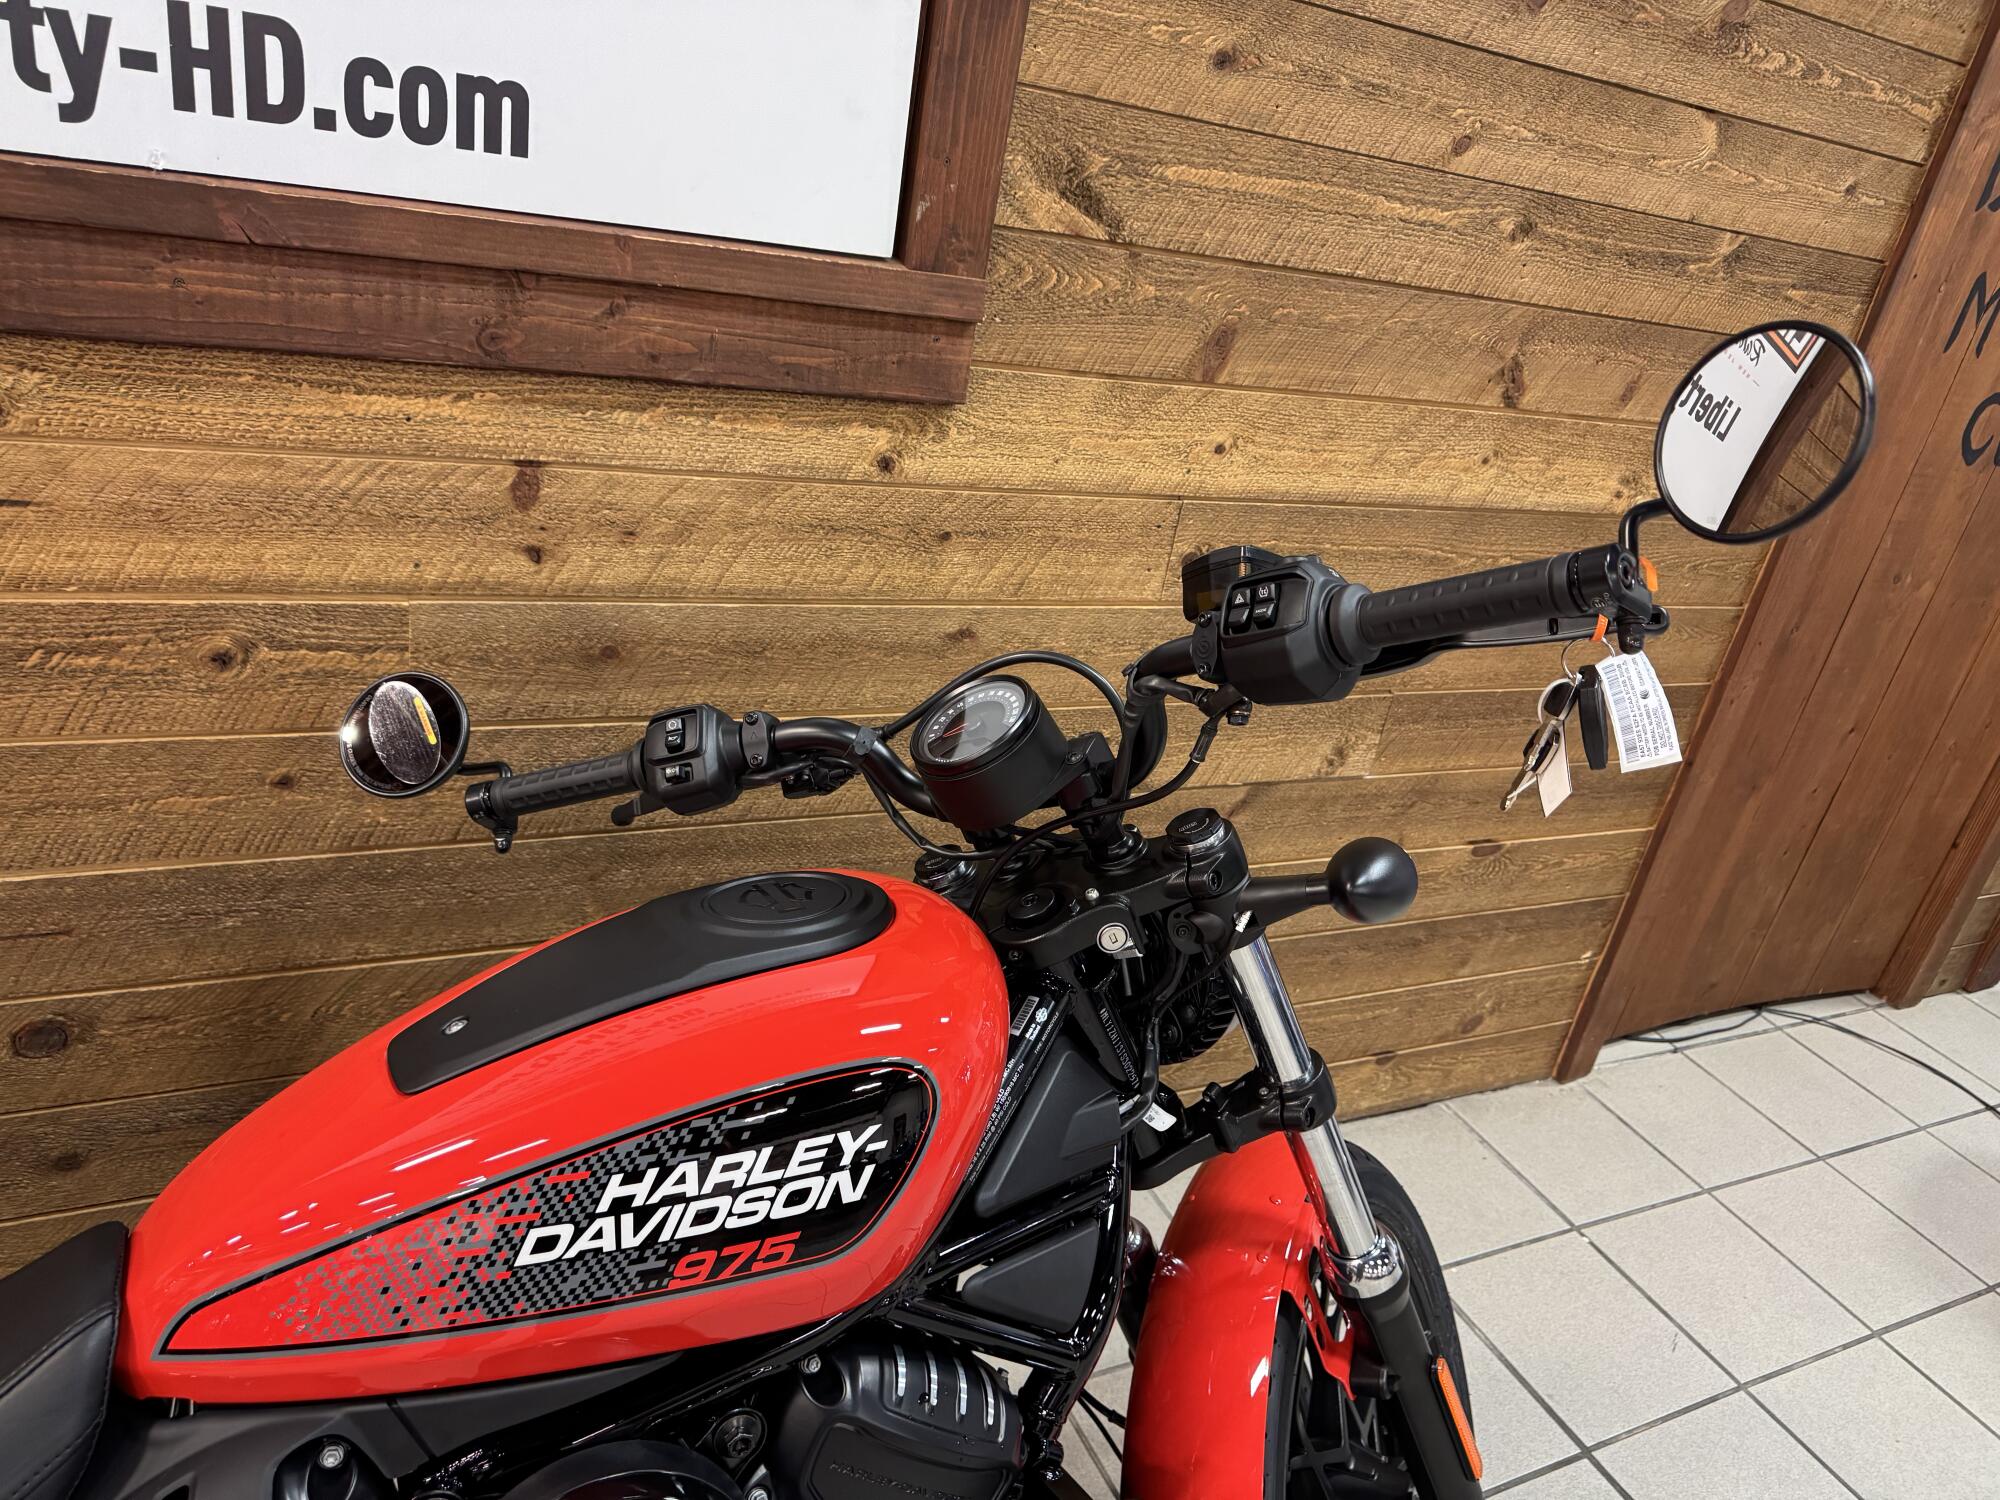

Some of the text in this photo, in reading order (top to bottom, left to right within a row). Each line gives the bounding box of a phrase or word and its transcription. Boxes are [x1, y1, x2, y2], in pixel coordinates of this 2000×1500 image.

[596, 1123, 888, 1213] HARLEY-
[514, 1165, 877, 1268] DAVIDSON
[669, 1231, 801, 1288] 975
